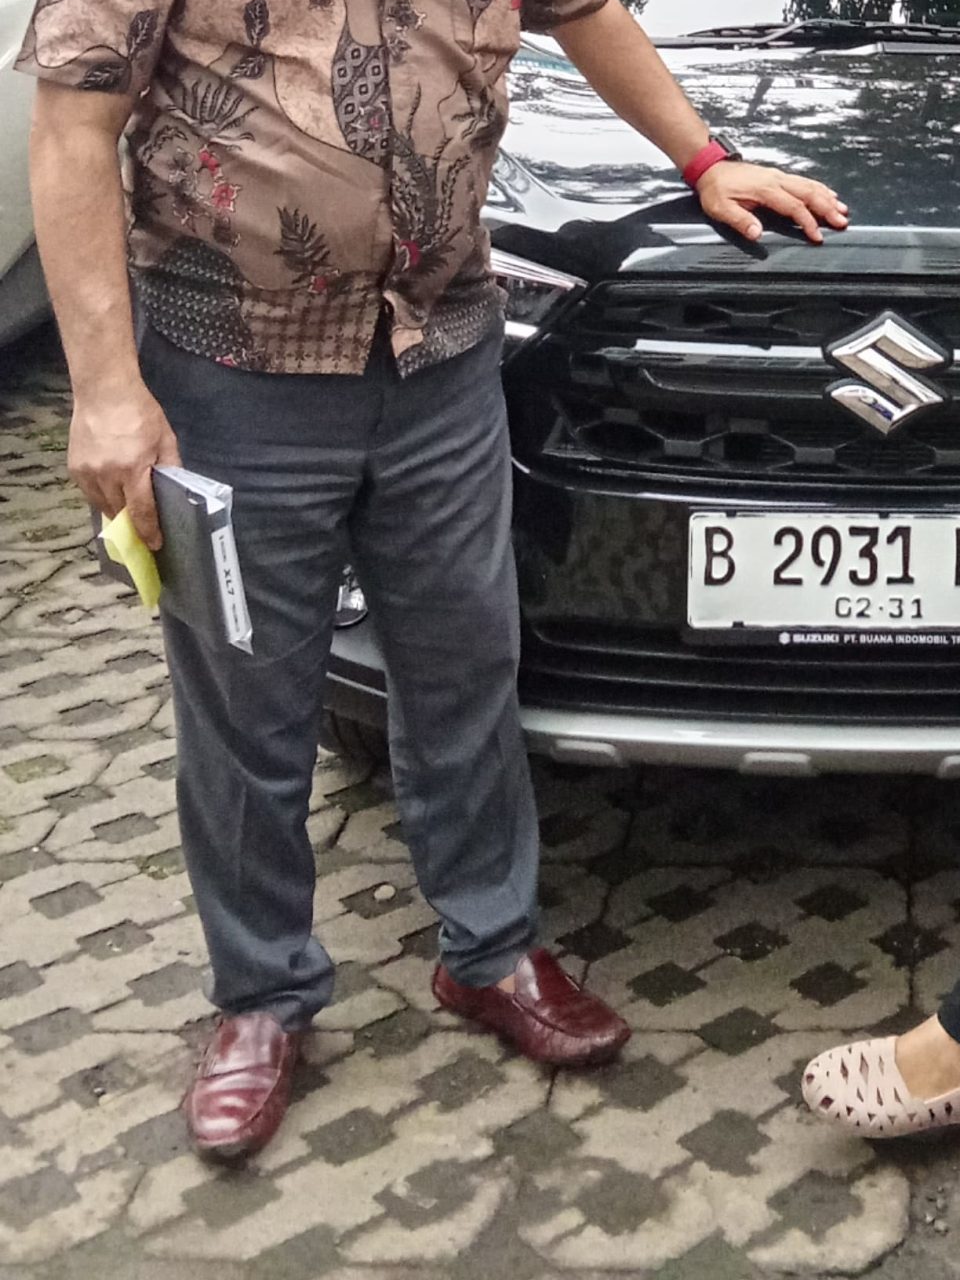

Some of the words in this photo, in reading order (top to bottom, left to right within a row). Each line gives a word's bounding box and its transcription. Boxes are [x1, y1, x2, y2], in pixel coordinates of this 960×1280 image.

[704, 526, 736, 586] B
[773, 525, 915, 587] 2931
[223, 569, 235, 596] XL7
[792, 633, 840, 644] SUZUKI
[843, 634, 858, 644] PT.
[859, 634, 893, 644] BUANA
[895, 634, 949, 645] INDOMOBIL
